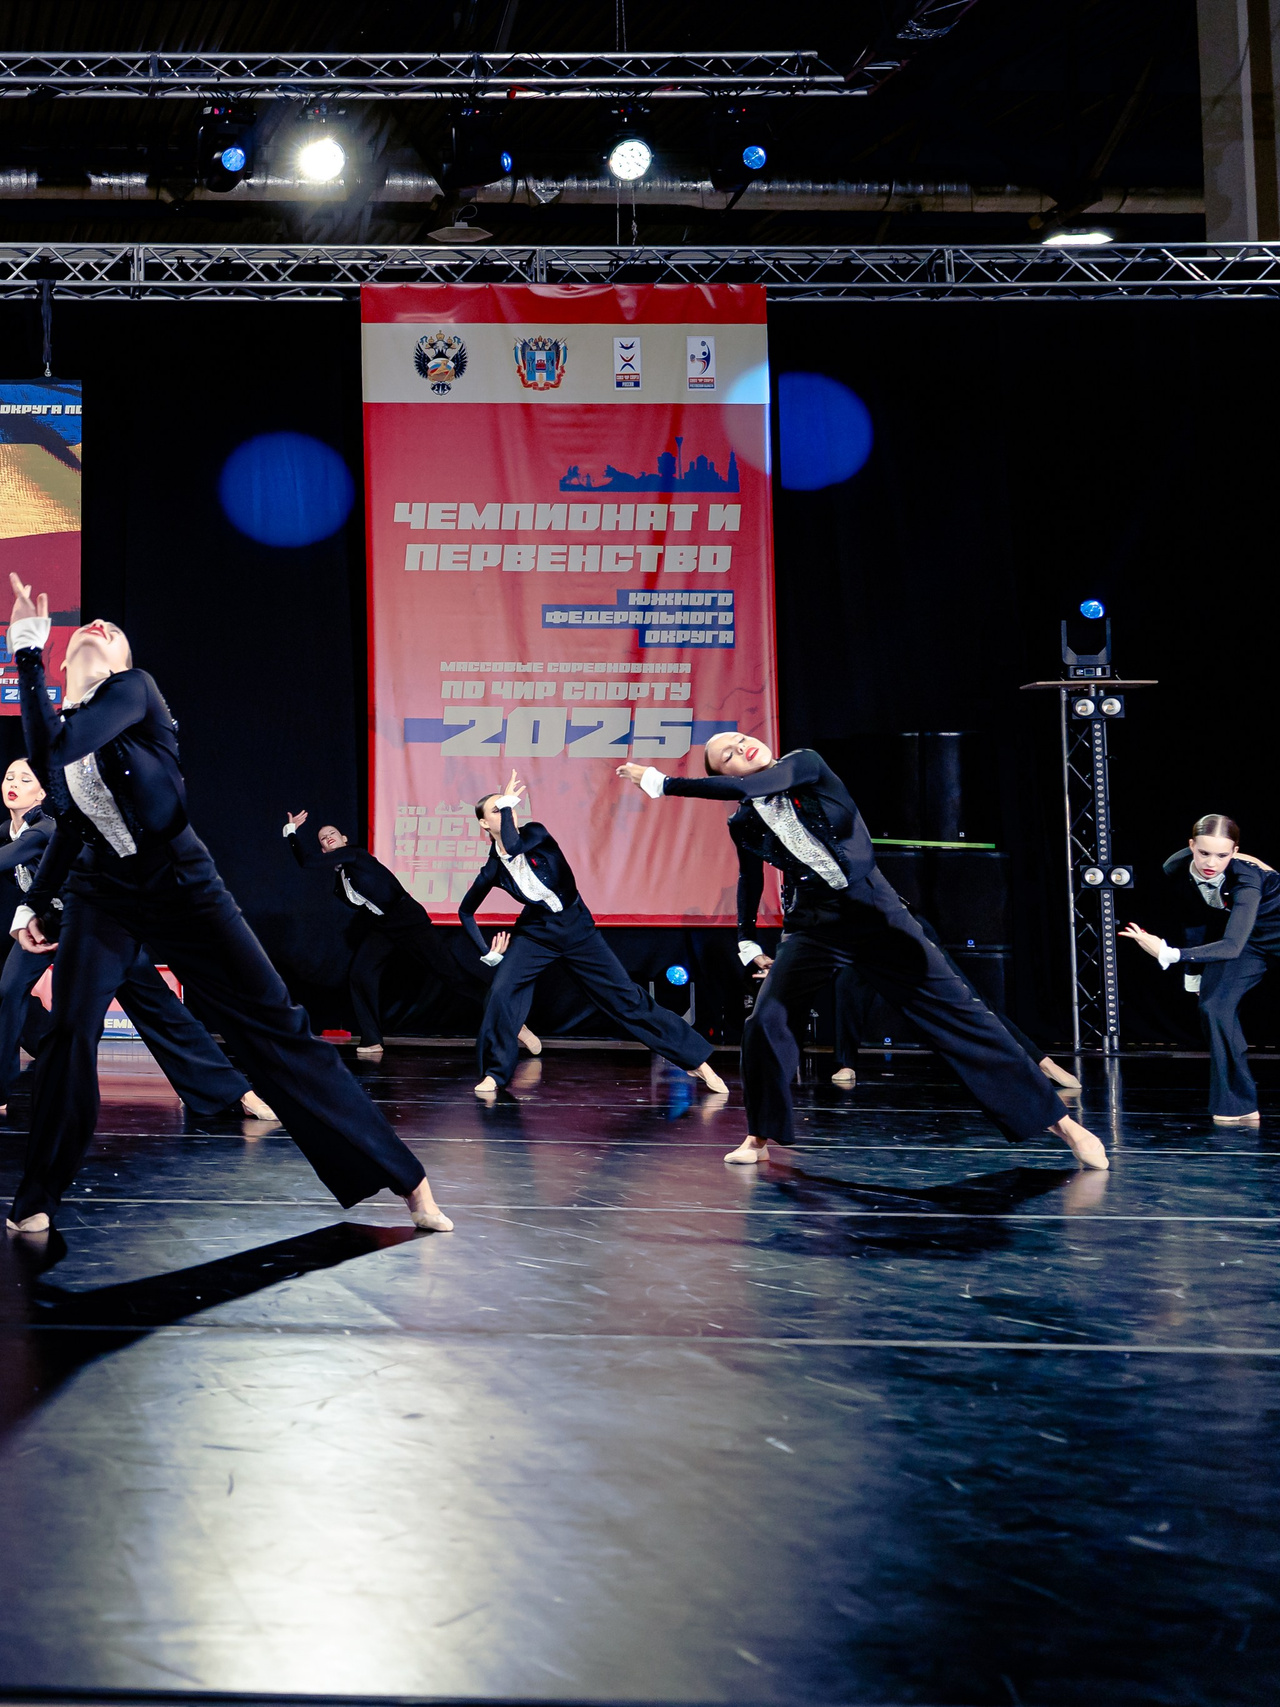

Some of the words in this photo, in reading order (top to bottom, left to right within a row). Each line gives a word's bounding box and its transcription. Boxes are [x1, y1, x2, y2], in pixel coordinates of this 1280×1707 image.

[0, 404, 63, 415] ОКРУГА
[393, 502, 699, 531] ЧЕМПИОНАТ
[707, 504, 742, 531] И
[404, 544, 733, 573] ПЕРВЕНСТВО
[628, 592, 733, 606] ЮЖНОГО
[545, 611, 734, 625] ФЕДЕРАЛЬНОГО
[644, 630, 734, 644] ОКРУГА
[440, 661, 544, 673] МАССОВЫЕ
[547, 661, 692, 674] СОРЕВНОВАНИЯ
[4, 688, 57, 701] 25
[440, 680, 486, 700] ПО
[490, 681, 557, 700] ЧИР
[563, 681, 692, 701] СПОРТУ
[440, 706, 694, 759] 2025
[398, 806, 427, 815] ЭТО
